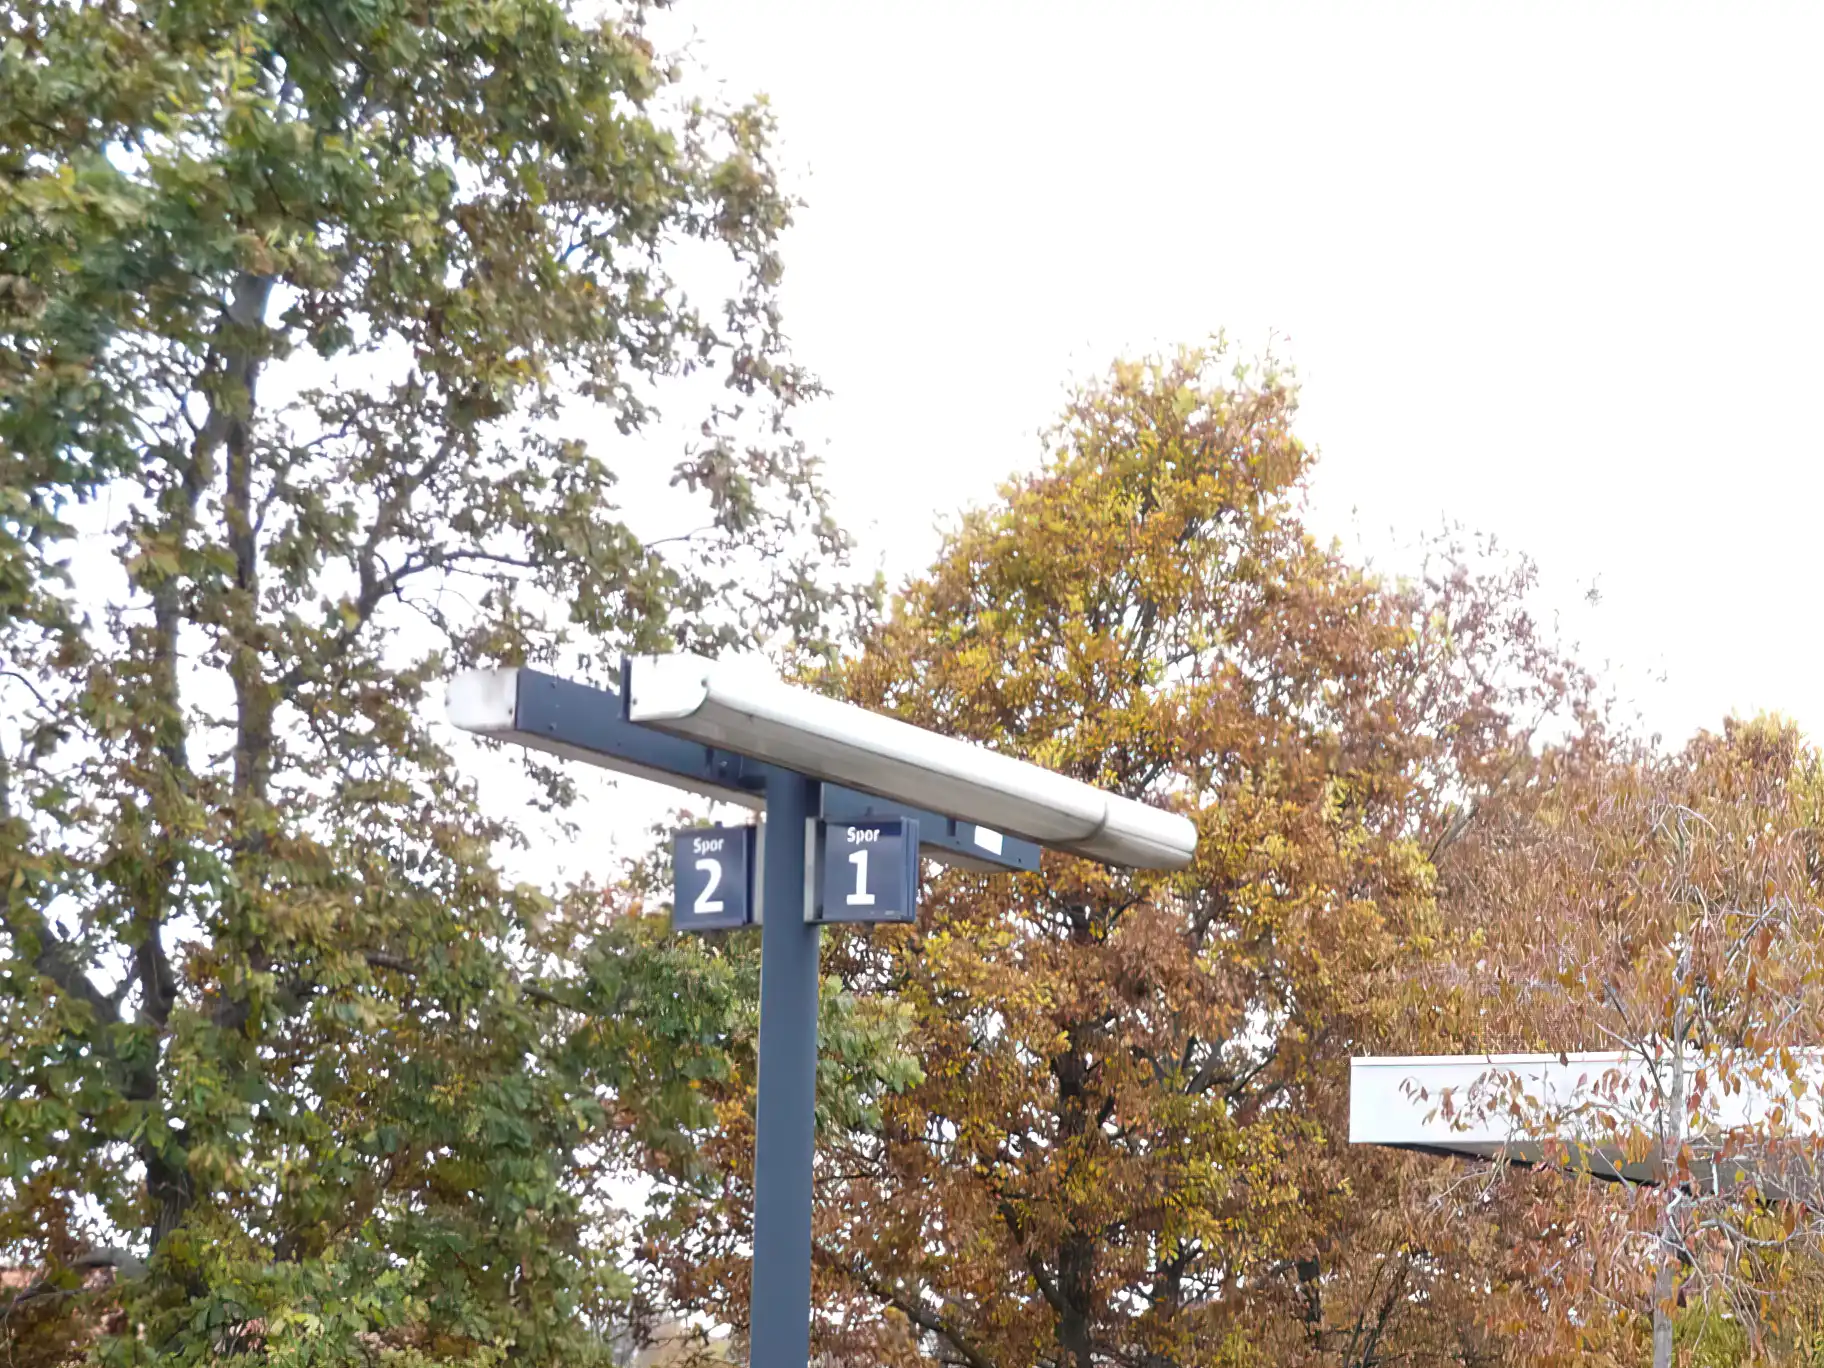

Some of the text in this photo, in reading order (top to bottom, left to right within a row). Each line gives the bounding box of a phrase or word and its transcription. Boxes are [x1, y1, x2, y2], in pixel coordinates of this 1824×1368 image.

[693, 837, 724, 856] Spor
[847, 826, 880, 845] Spor
[693, 858, 724, 914] 2
[846, 849, 876, 905] 1
